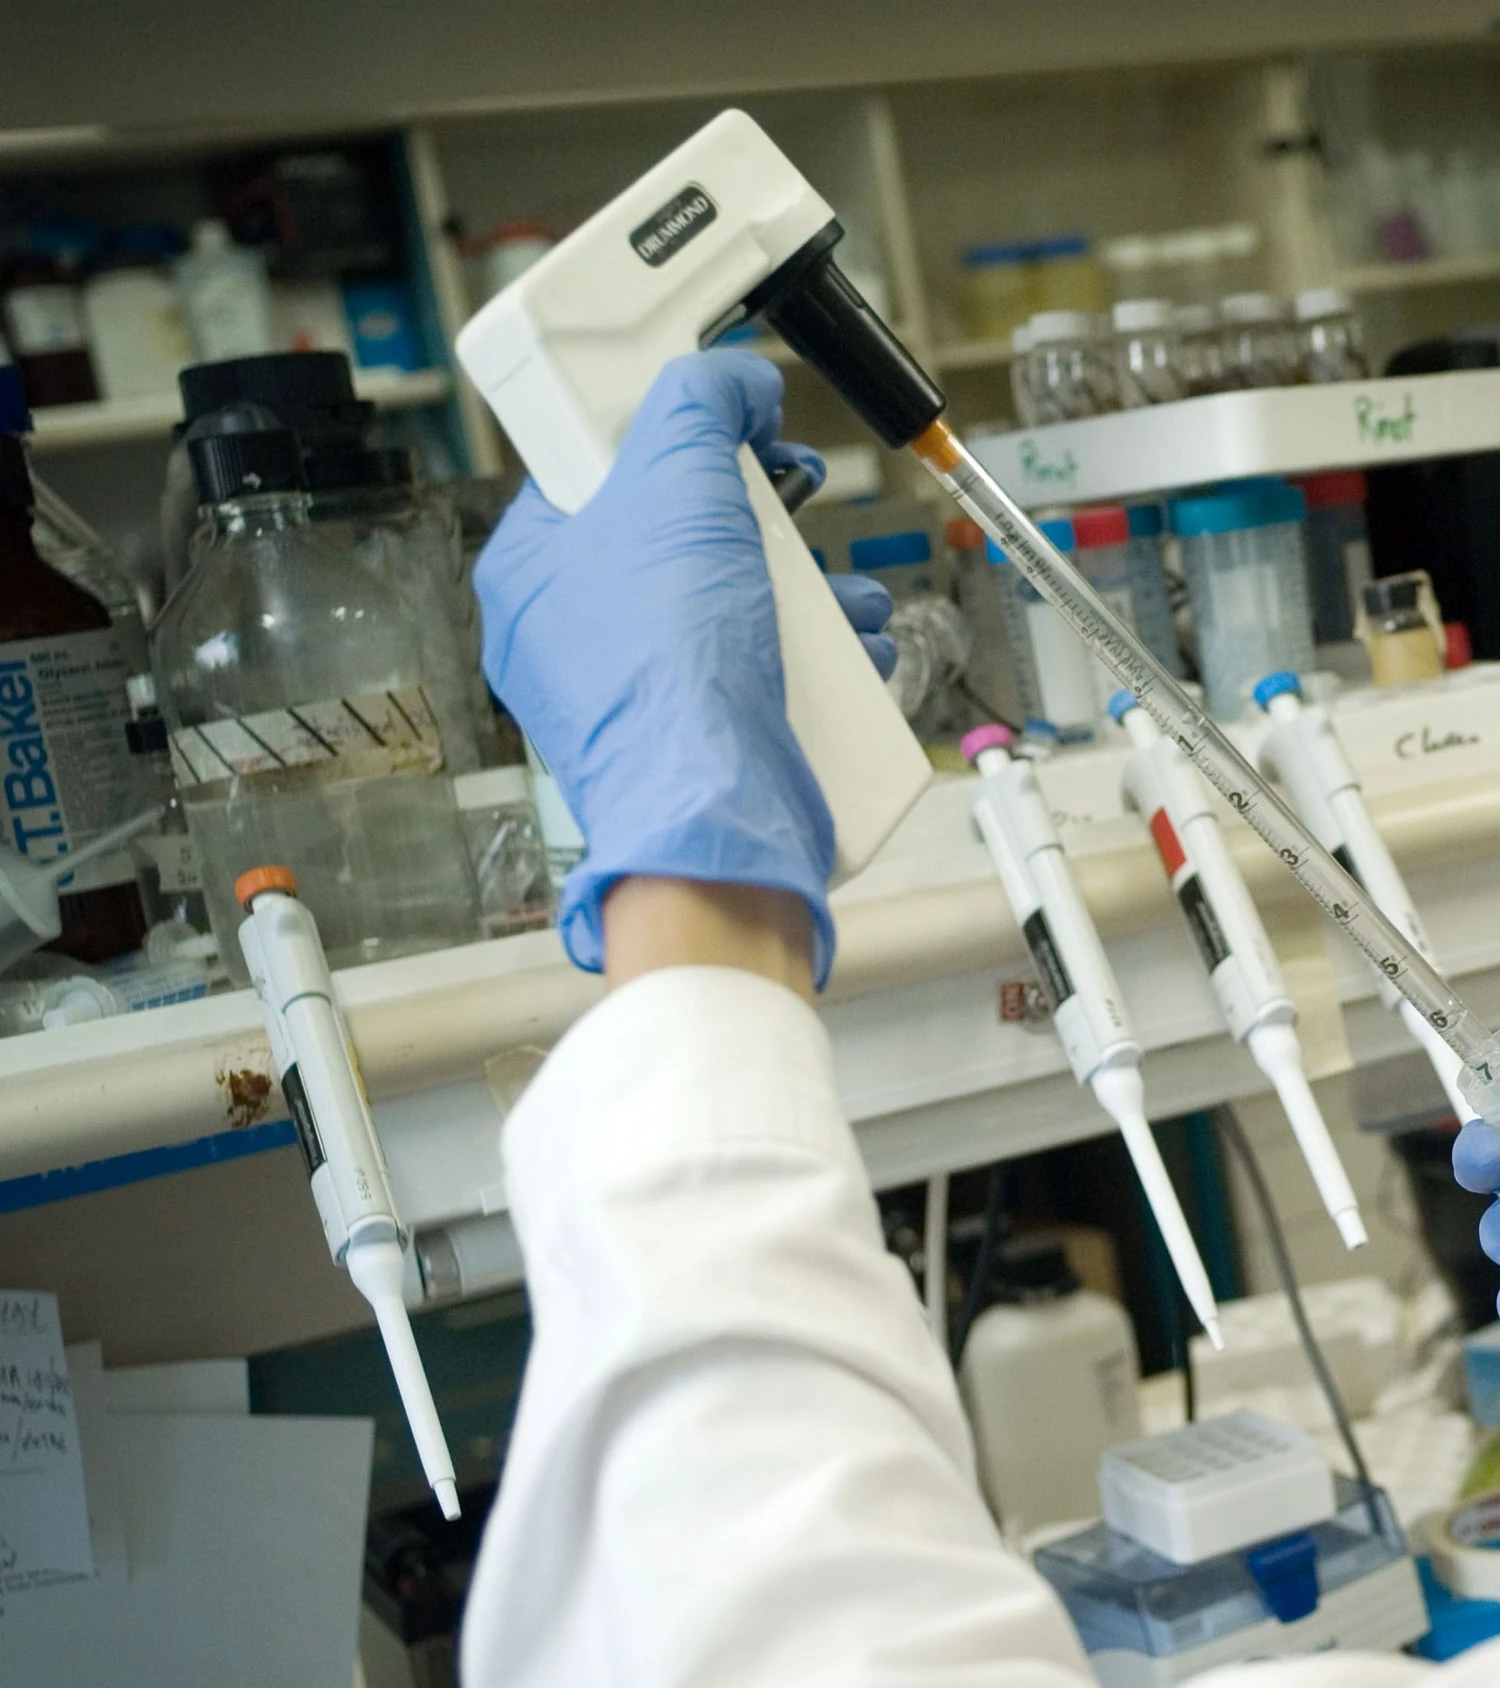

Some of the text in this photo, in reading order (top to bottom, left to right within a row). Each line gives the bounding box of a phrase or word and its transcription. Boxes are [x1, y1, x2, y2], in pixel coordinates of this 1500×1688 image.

[637, 195, 709, 260] DRUMMOND
[1178, 734, 1195, 752] 1
[1228, 791, 1250, 811] 2
[1279, 847, 1299, 867] 3
[1332, 902, 1350, 921] 4
[1379, 956, 1399, 976] 5
[1429, 1010, 1449, 1029] 6
[1475, 1062, 1493, 1081] 7
